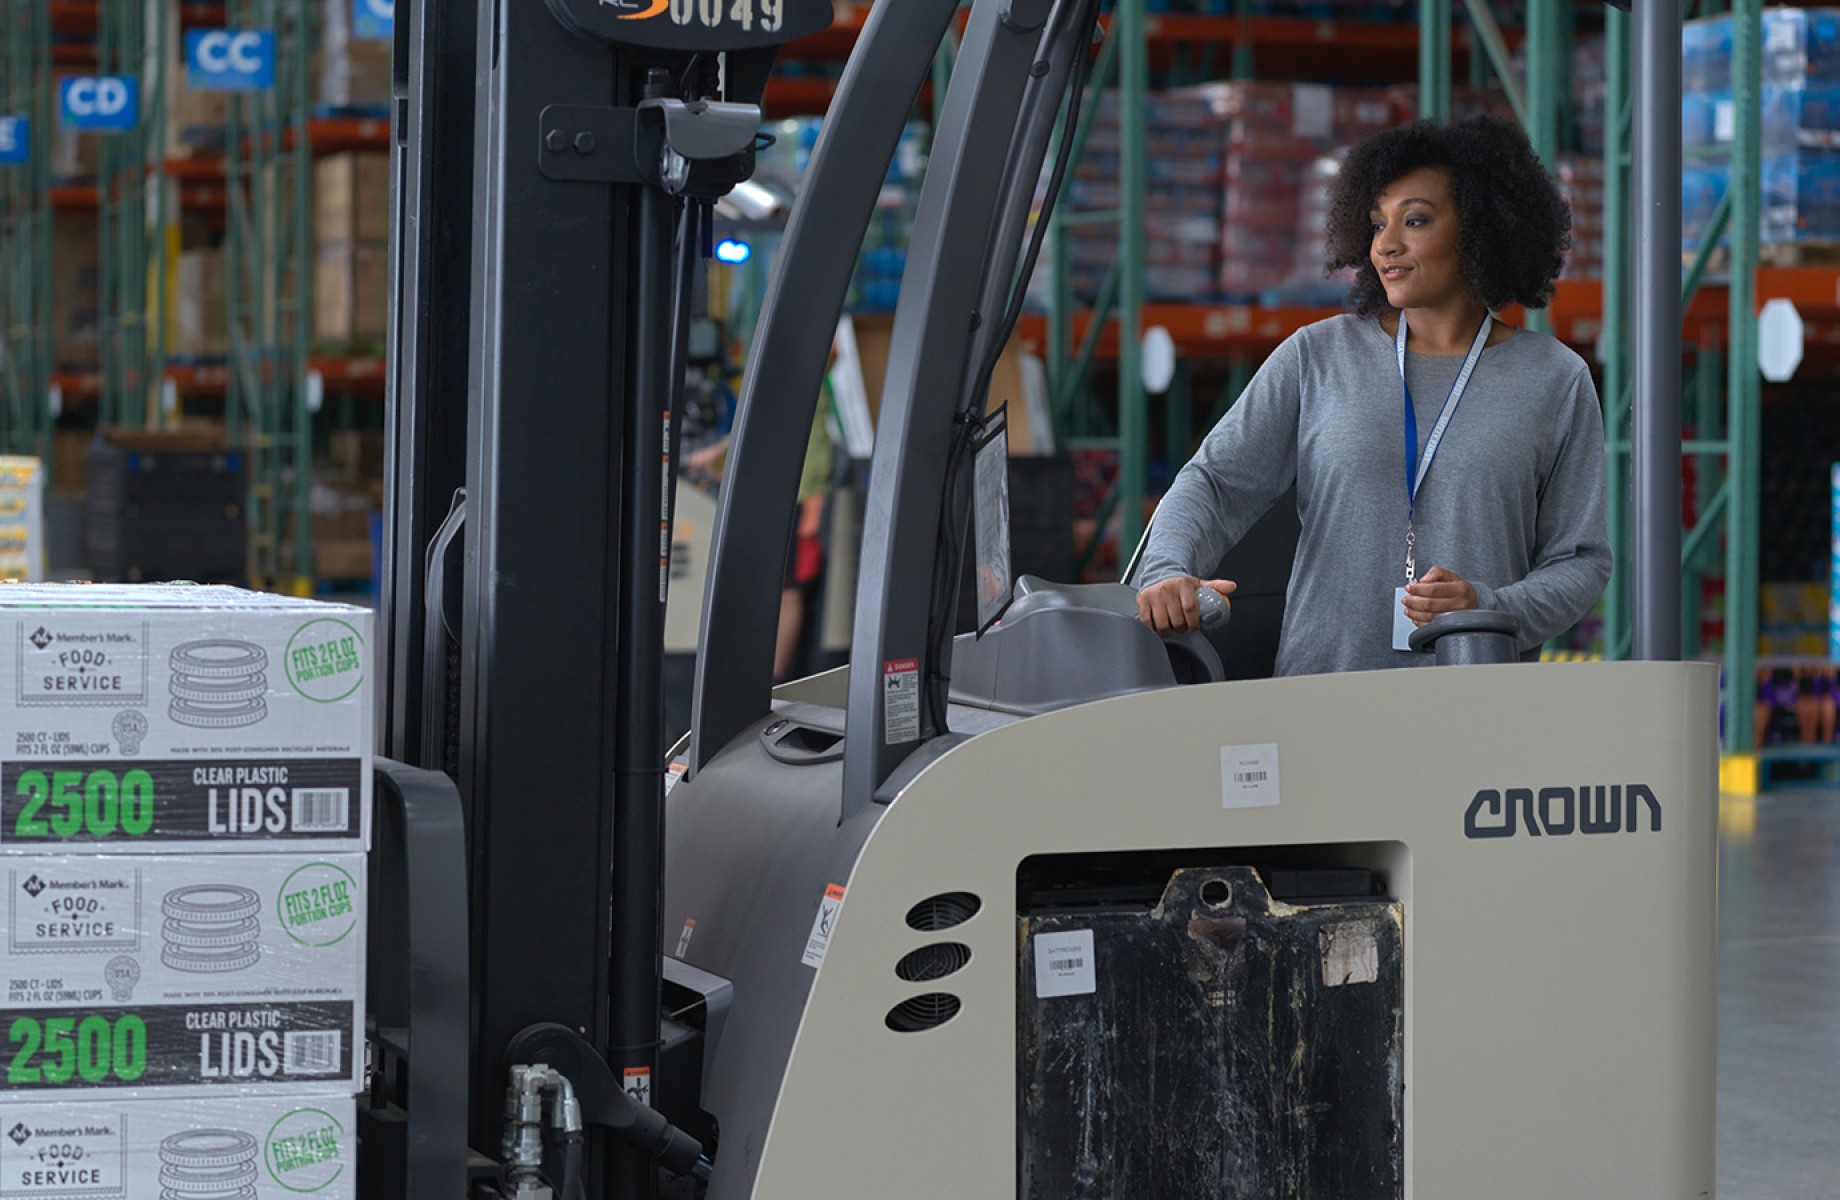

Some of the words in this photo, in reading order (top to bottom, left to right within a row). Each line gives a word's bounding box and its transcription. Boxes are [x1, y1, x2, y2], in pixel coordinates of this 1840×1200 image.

[670, 0, 783, 32] 0049
[196, 31, 262, 73] CC
[66, 77, 128, 116] CD
[56, 632, 104, 642] Member's
[59, 649, 105, 668] FOOD
[292, 646, 317, 672] FITS
[43, 675, 122, 690] SERVICE
[193, 767, 233, 785] CLEAR
[235, 766, 288, 784] PLASTIC
[15, 769, 154, 837] 2500
[208, 787, 287, 833] LIDS
[1464, 784, 1662, 839] CROWN
[48, 880, 97, 889] Member's
[52, 897, 98, 914] FOOD
[285, 889, 311, 915] FITS
[36, 922, 114, 937] SERVICE
[185, 1012, 226, 1029] CLEAR
[229, 1010, 281, 1028] PLASTIC
[8, 1014, 147, 1084] 2500
[201, 1030, 280, 1077] LIDS
[35, 1127, 82, 1137] Member's
[38, 1144, 84, 1162] FOOD
[22, 1169, 100, 1185] SERVICE
